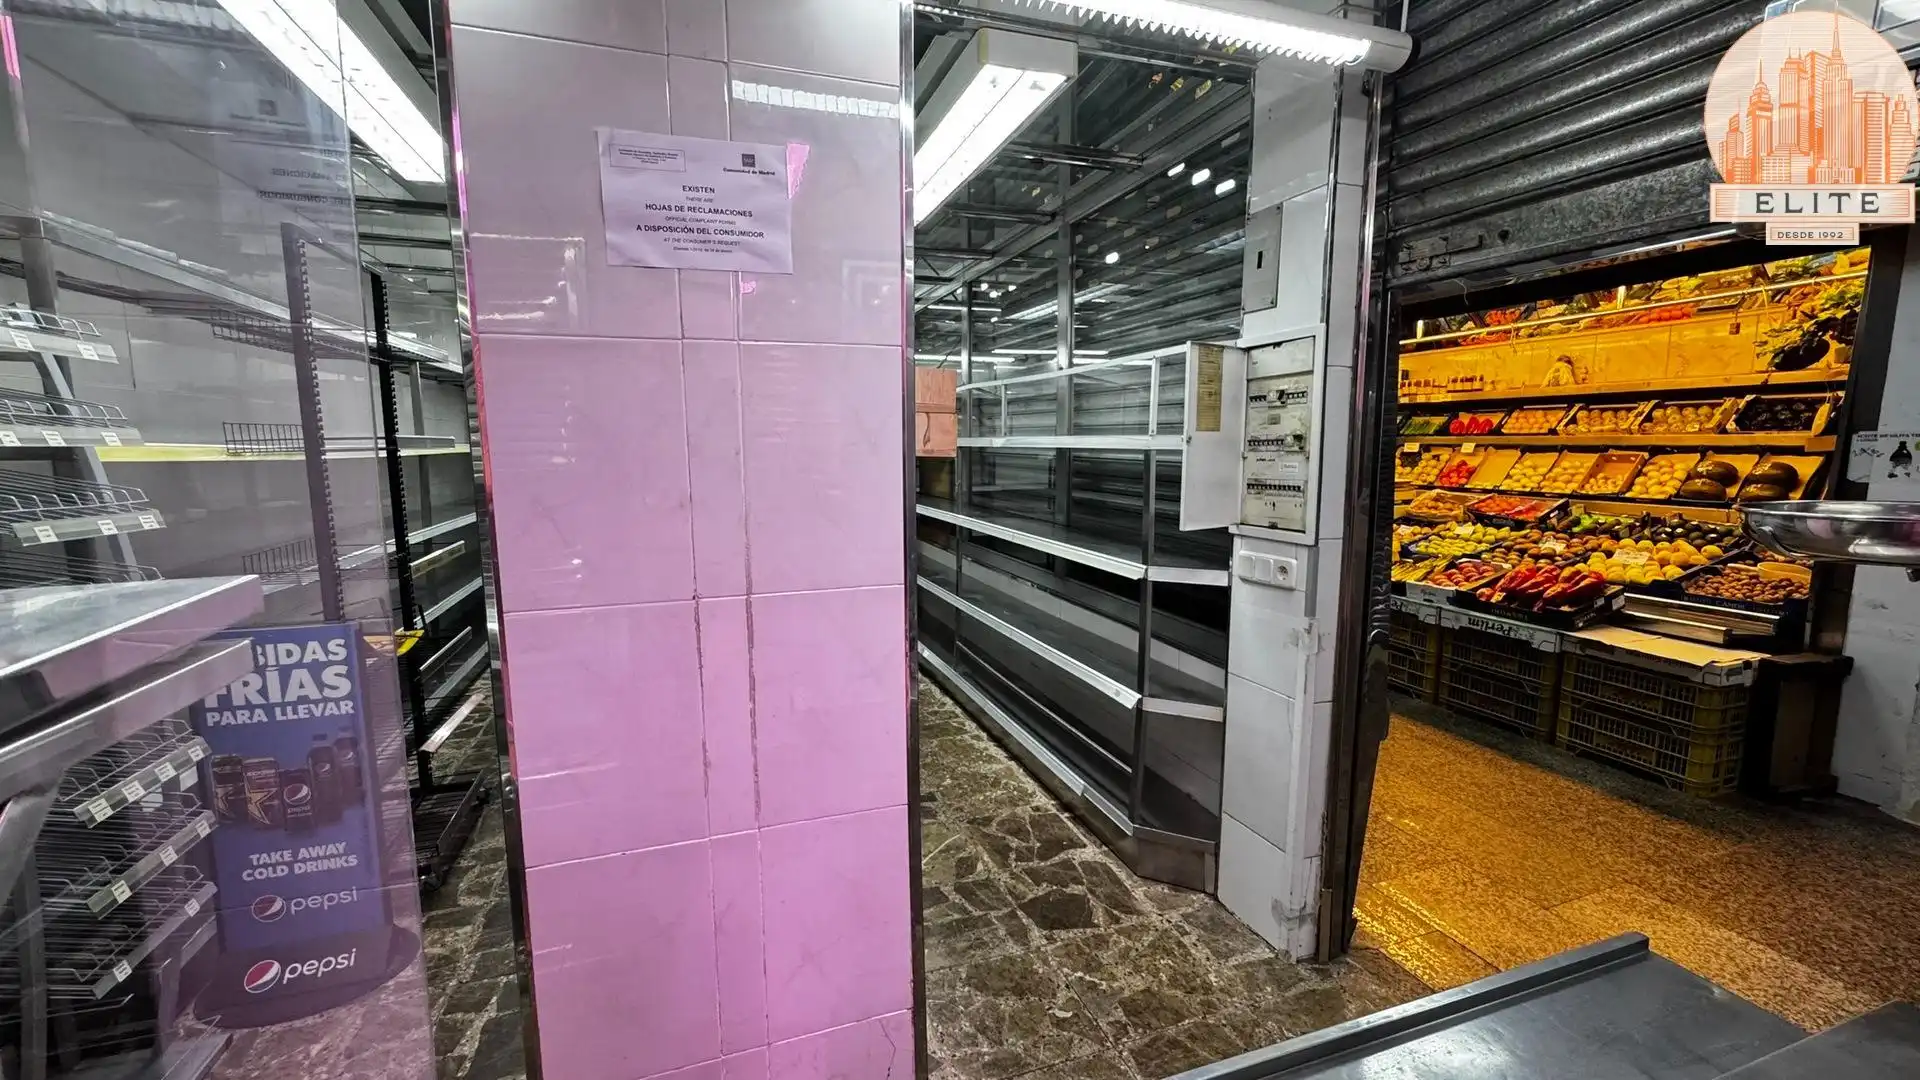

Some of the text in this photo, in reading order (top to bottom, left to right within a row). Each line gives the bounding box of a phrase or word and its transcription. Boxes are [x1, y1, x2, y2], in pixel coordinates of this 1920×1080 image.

[682, 185, 715, 194] EXISTEN
[645, 203, 672, 212] HOJAS
[687, 206, 753, 218] RECLAMACIONES
[644, 224, 695, 234] DISPOSICIÓN
[696, 227, 711, 235] DEL
[713, 228, 765, 238] CONSUMIDOR
[1467, 616, 1514, 637] Perlim
[206, 700, 355, 726] PARA LLEVAR
[249, 841, 347, 866] TAKE AWAY
[242, 854, 359, 881] COLD DRINKS
[290, 886, 358, 915] pepsi
[282, 948, 357, 984] pepsi
